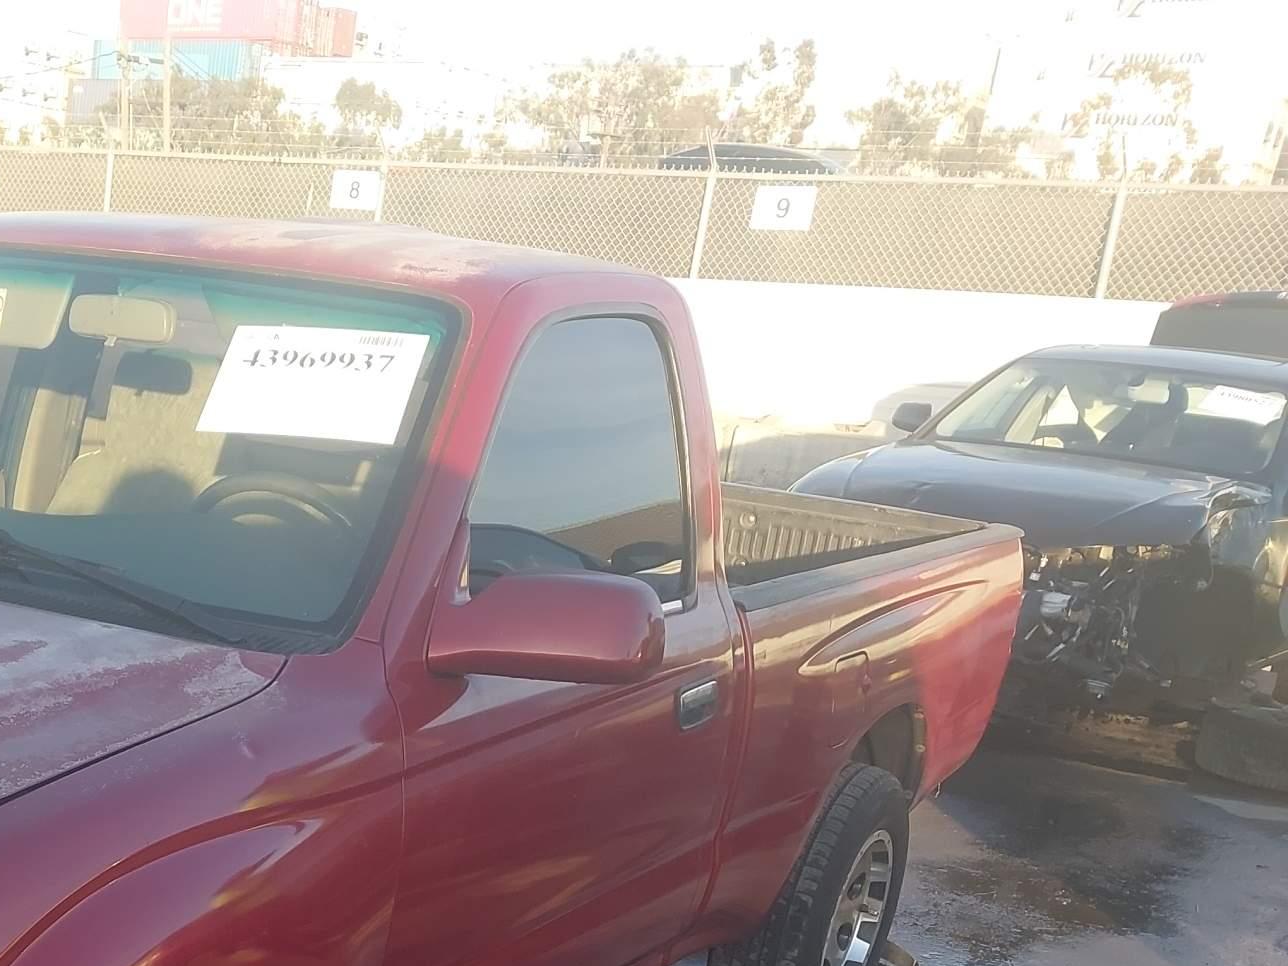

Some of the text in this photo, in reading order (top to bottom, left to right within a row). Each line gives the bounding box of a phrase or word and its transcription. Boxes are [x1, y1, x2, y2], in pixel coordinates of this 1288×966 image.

[349, 181, 360, 199] 8
[776, 198, 790, 219] 9
[242, 348, 397, 373] 43969937
